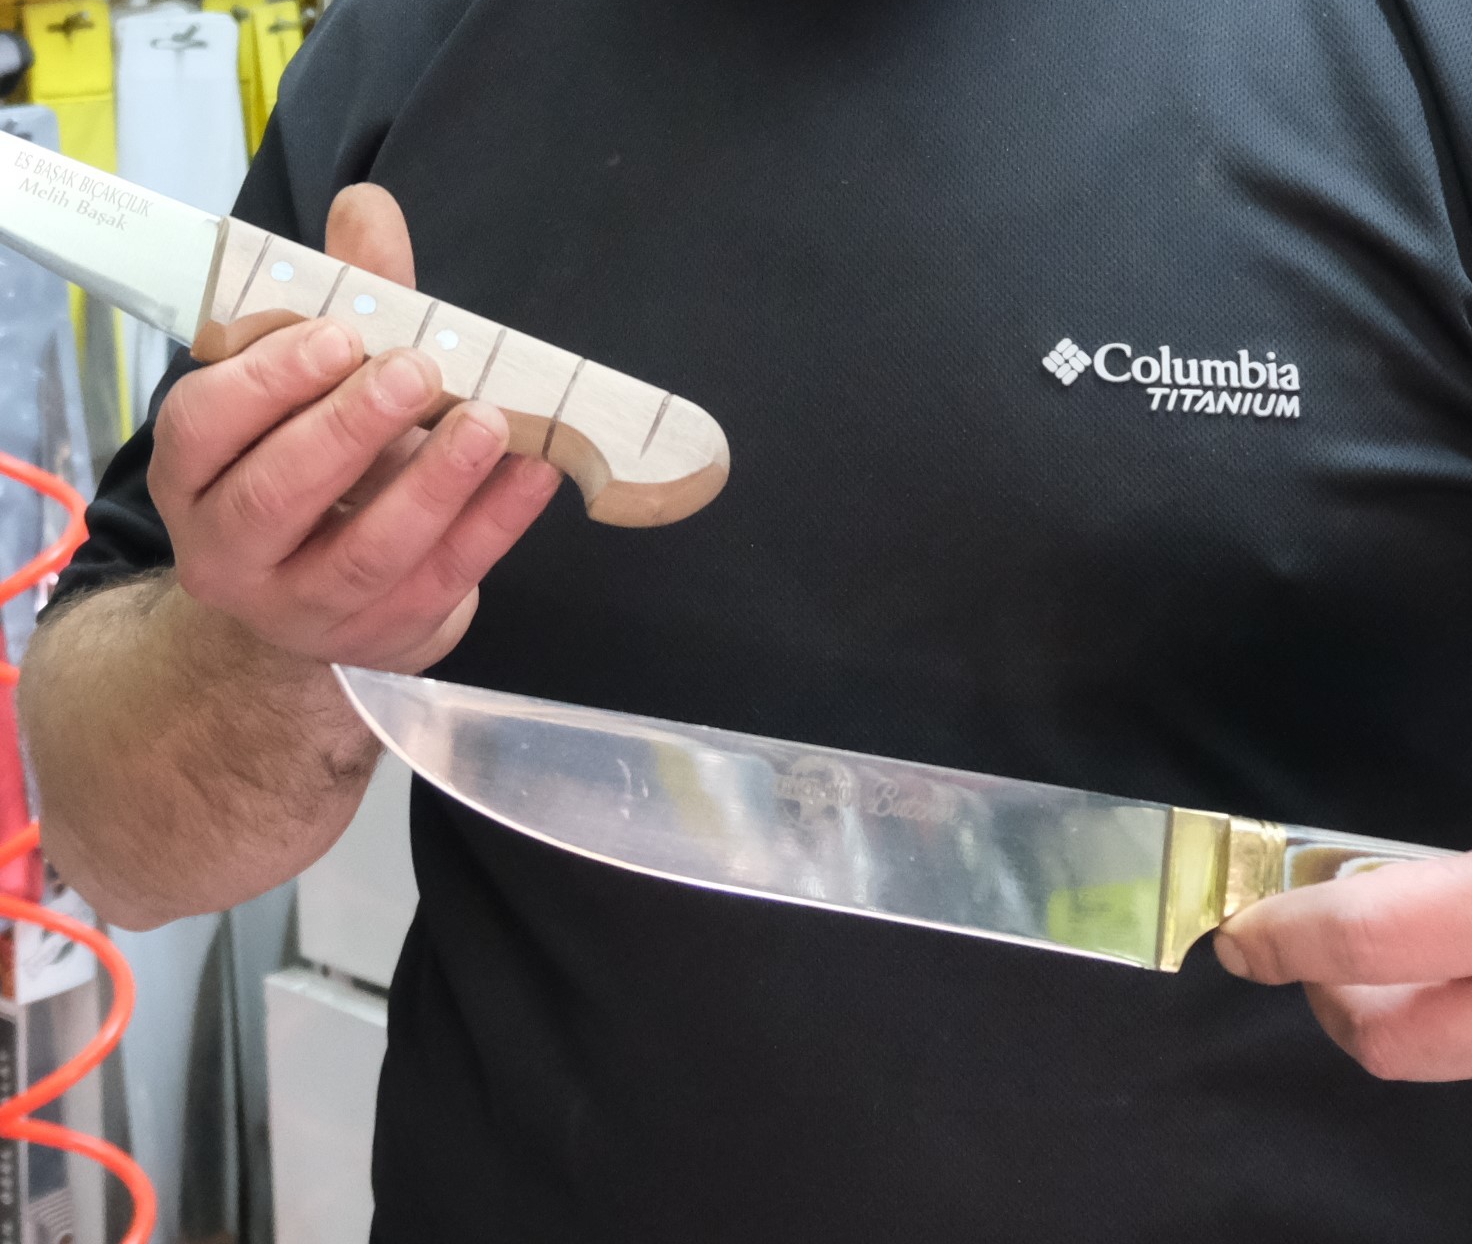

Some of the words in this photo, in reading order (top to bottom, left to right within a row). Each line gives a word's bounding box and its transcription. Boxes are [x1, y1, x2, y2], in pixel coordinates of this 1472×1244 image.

[14, 150, 34, 171] ES
[18, 177, 71, 209] Melih
[77, 199, 129, 232] Başak
[1093, 342, 1301, 391] Columbia
[1146, 387, 1301, 418] TITANIUM
